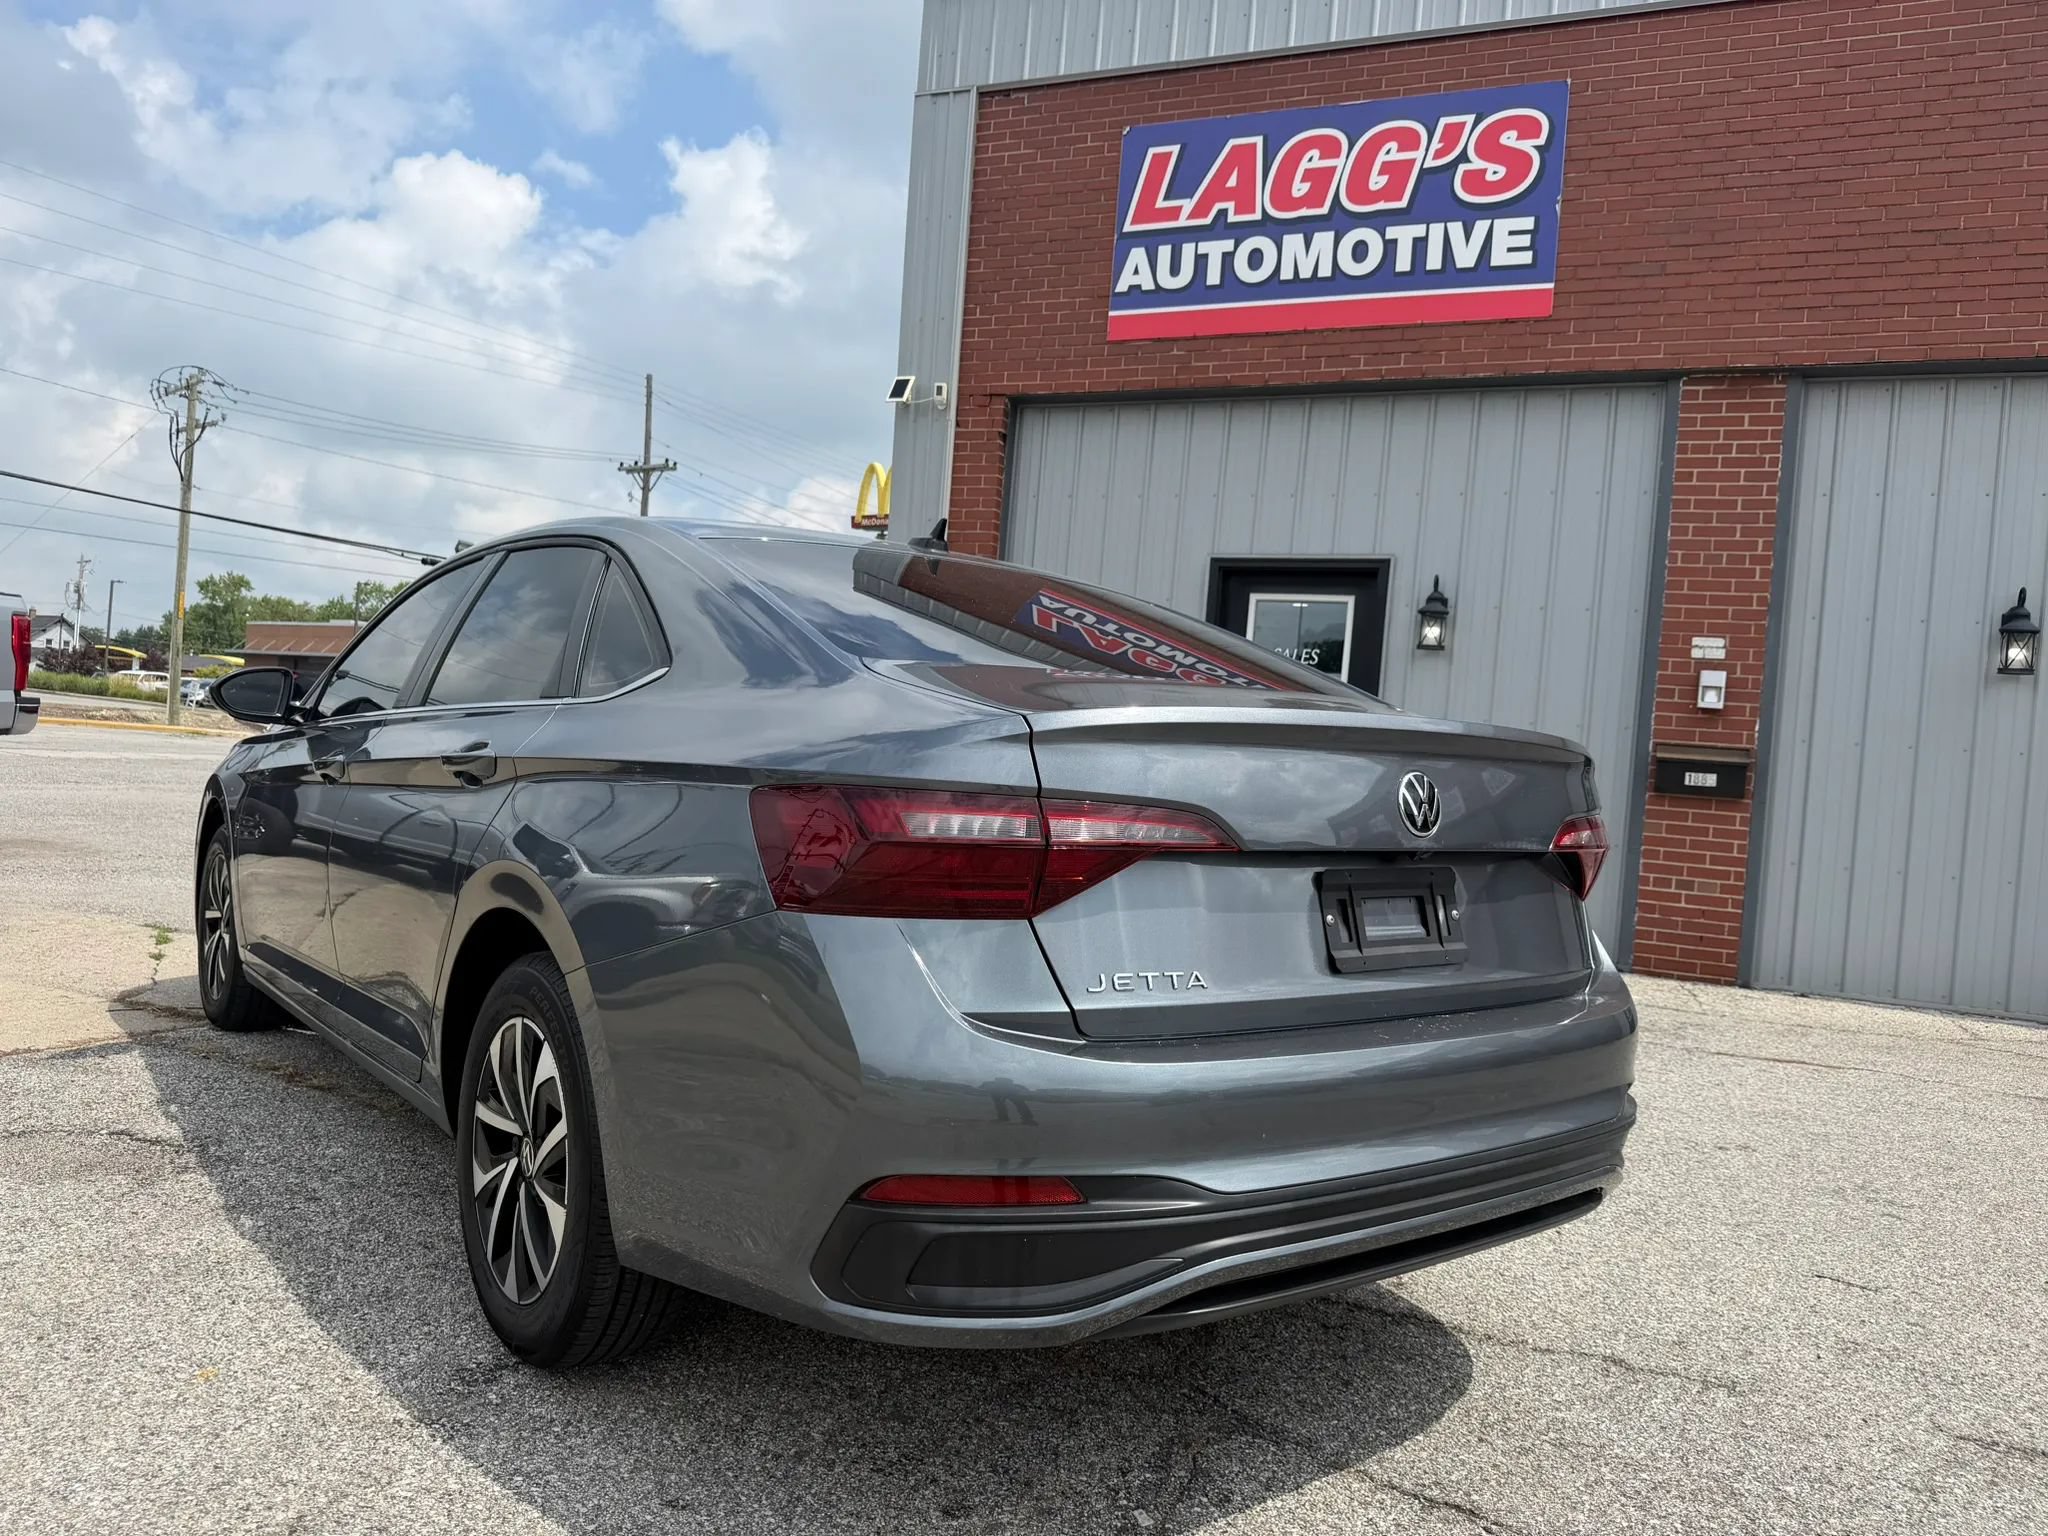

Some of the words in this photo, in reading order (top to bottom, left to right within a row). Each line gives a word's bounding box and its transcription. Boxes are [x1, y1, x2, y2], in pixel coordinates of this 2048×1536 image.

[1122, 108, 1549, 233] LAGG'S
[1114, 216, 1535, 292] AUTOMOTIVE
[861, 517, 888, 526] McDona
[1087, 971, 1208, 993] JETTA
